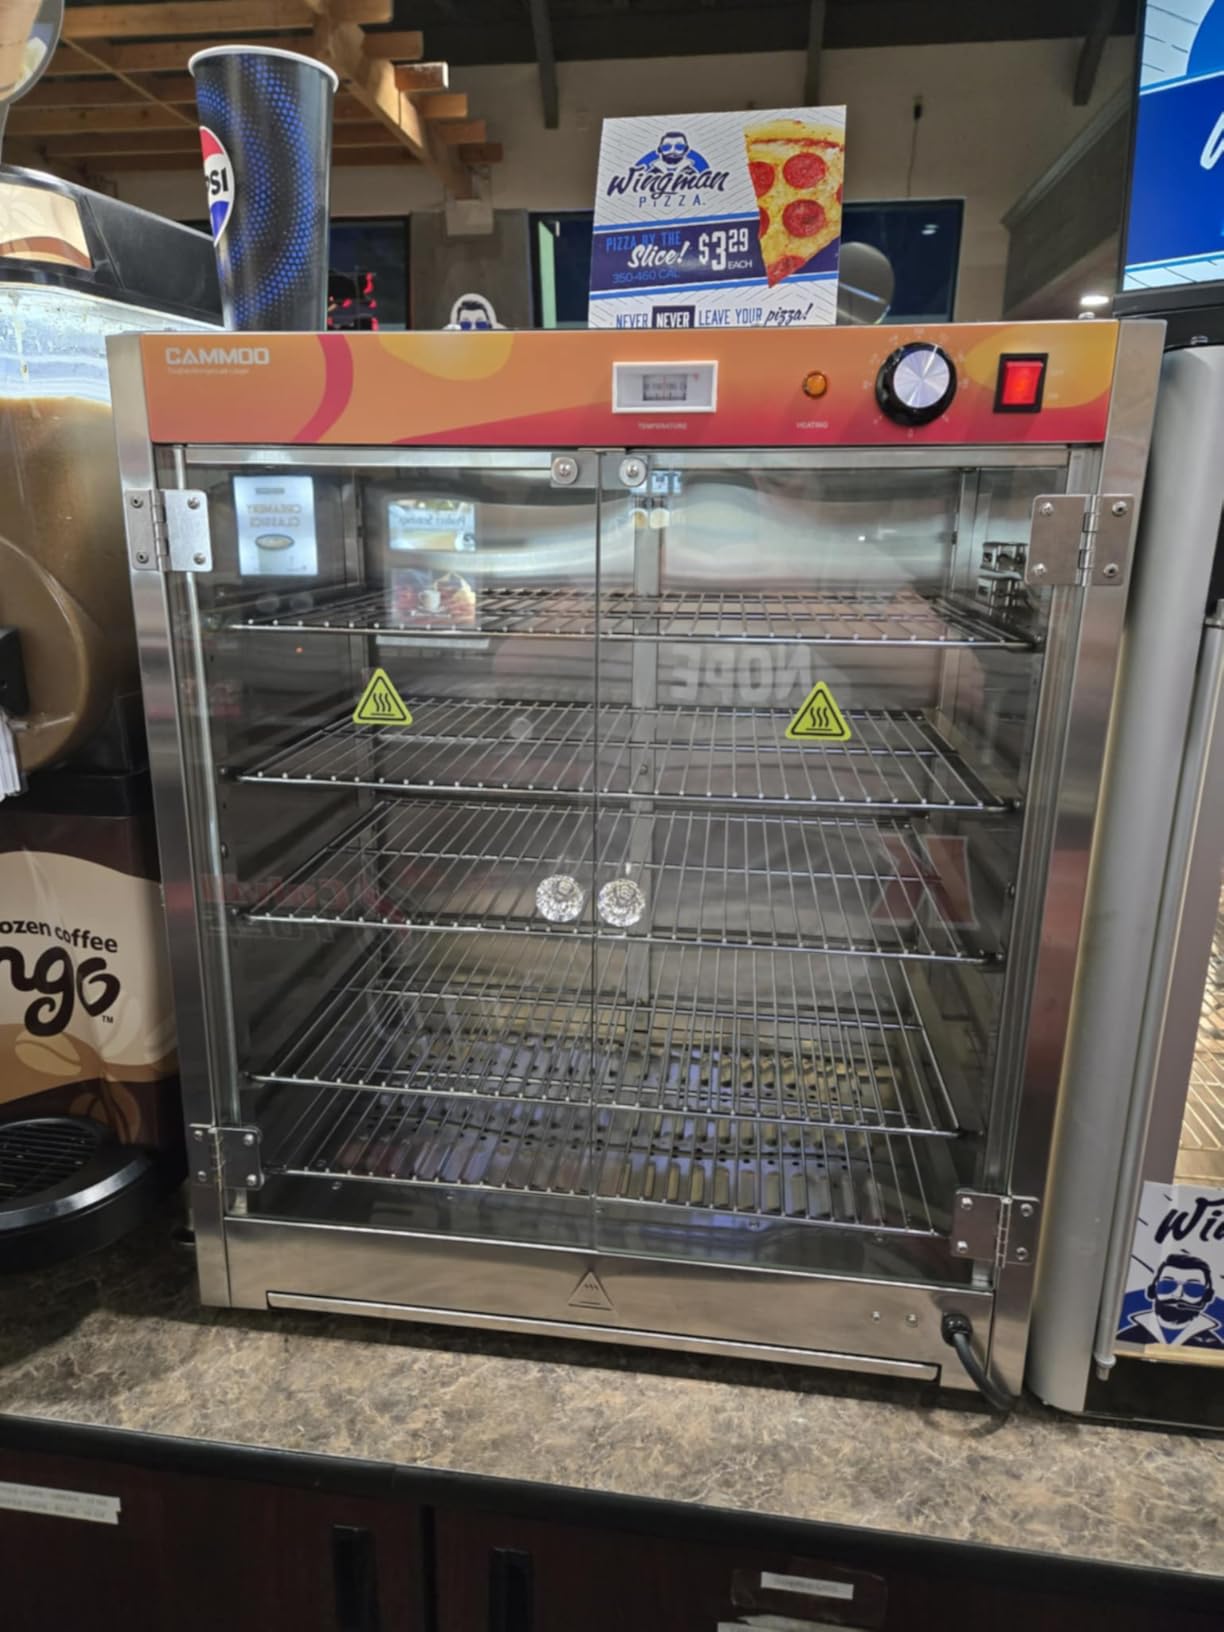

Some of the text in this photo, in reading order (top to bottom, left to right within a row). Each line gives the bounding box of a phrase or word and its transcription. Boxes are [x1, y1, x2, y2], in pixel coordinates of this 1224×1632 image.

[205, 167, 229, 196] SI
[607, 166, 730, 200] Wingman
[638, 194, 702, 208] PIZZA
[605, 230, 682, 253] PIZZA BY THE
[627, 240, 691, 269] Slice!
[727, 259, 753, 270] EACH
[616, 302, 814, 328] NEVER NEVER LEAVE YOUR pizza!
[54, 925, 119, 953] coffee
